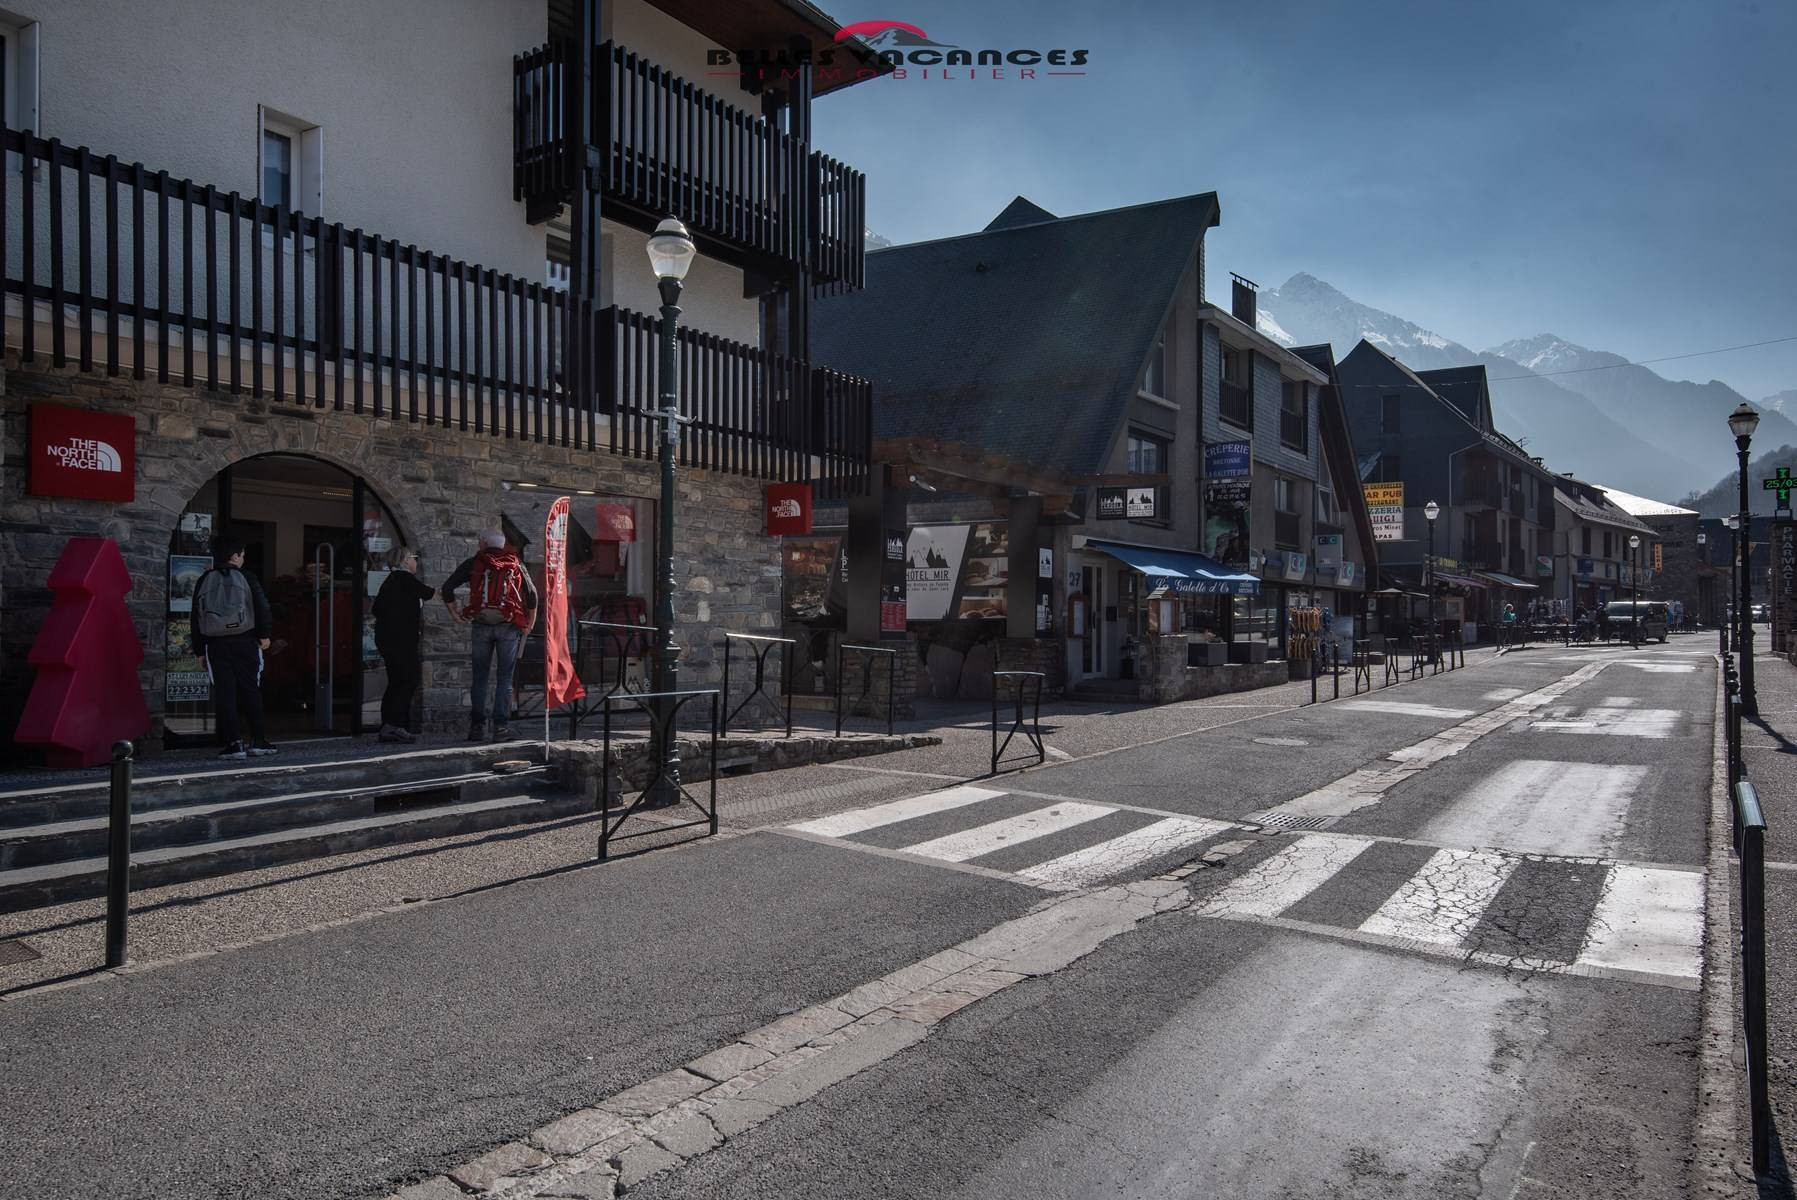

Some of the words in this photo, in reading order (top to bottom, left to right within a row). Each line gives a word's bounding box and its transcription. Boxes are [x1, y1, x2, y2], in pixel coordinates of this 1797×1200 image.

[69, 437, 97, 451] THE
[47, 445, 97, 461] NORTH
[62, 457, 97, 470] FACE
[1382, 490, 1402, 498] PUB
[772, 505, 791, 513] NORTH
[1368, 507, 1402, 515] ZZERIA
[1370, 515, 1395, 523] UIGI
[1781, 526, 1795, 595] PHARMACIE
[934, 570, 949, 581] MIR
[1069, 571, 1080, 586] 27
